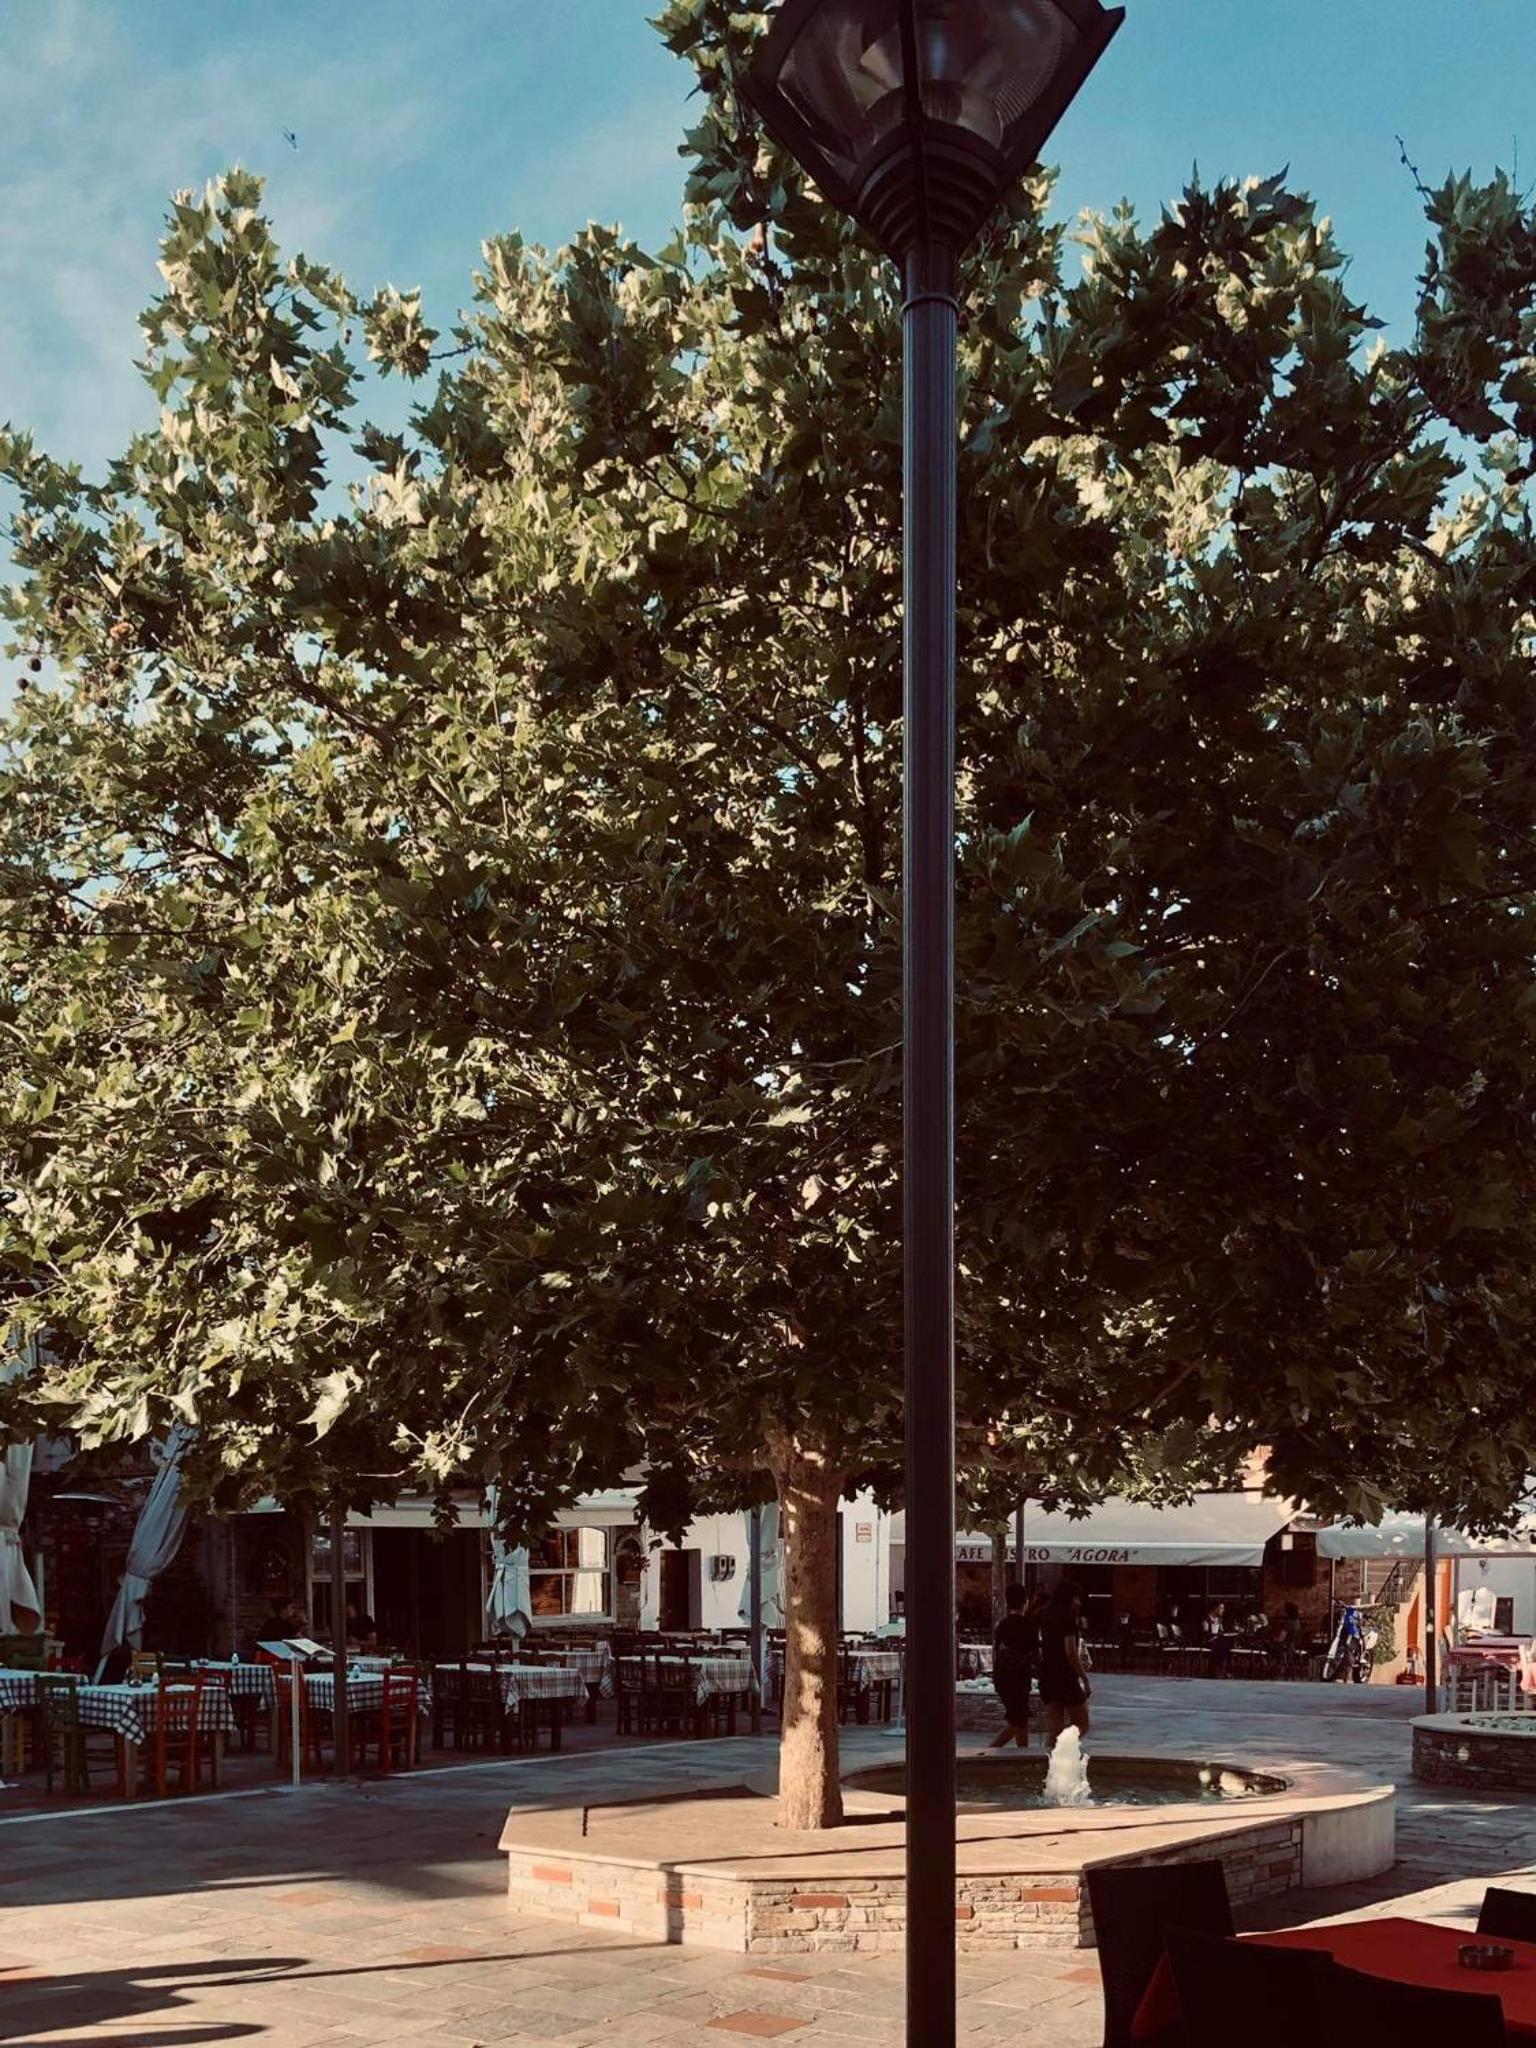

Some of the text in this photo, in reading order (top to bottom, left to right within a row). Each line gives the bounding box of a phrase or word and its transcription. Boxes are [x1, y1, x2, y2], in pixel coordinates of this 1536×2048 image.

[956, 1547, 1139, 1563] AFE ISRO "AGORA"
